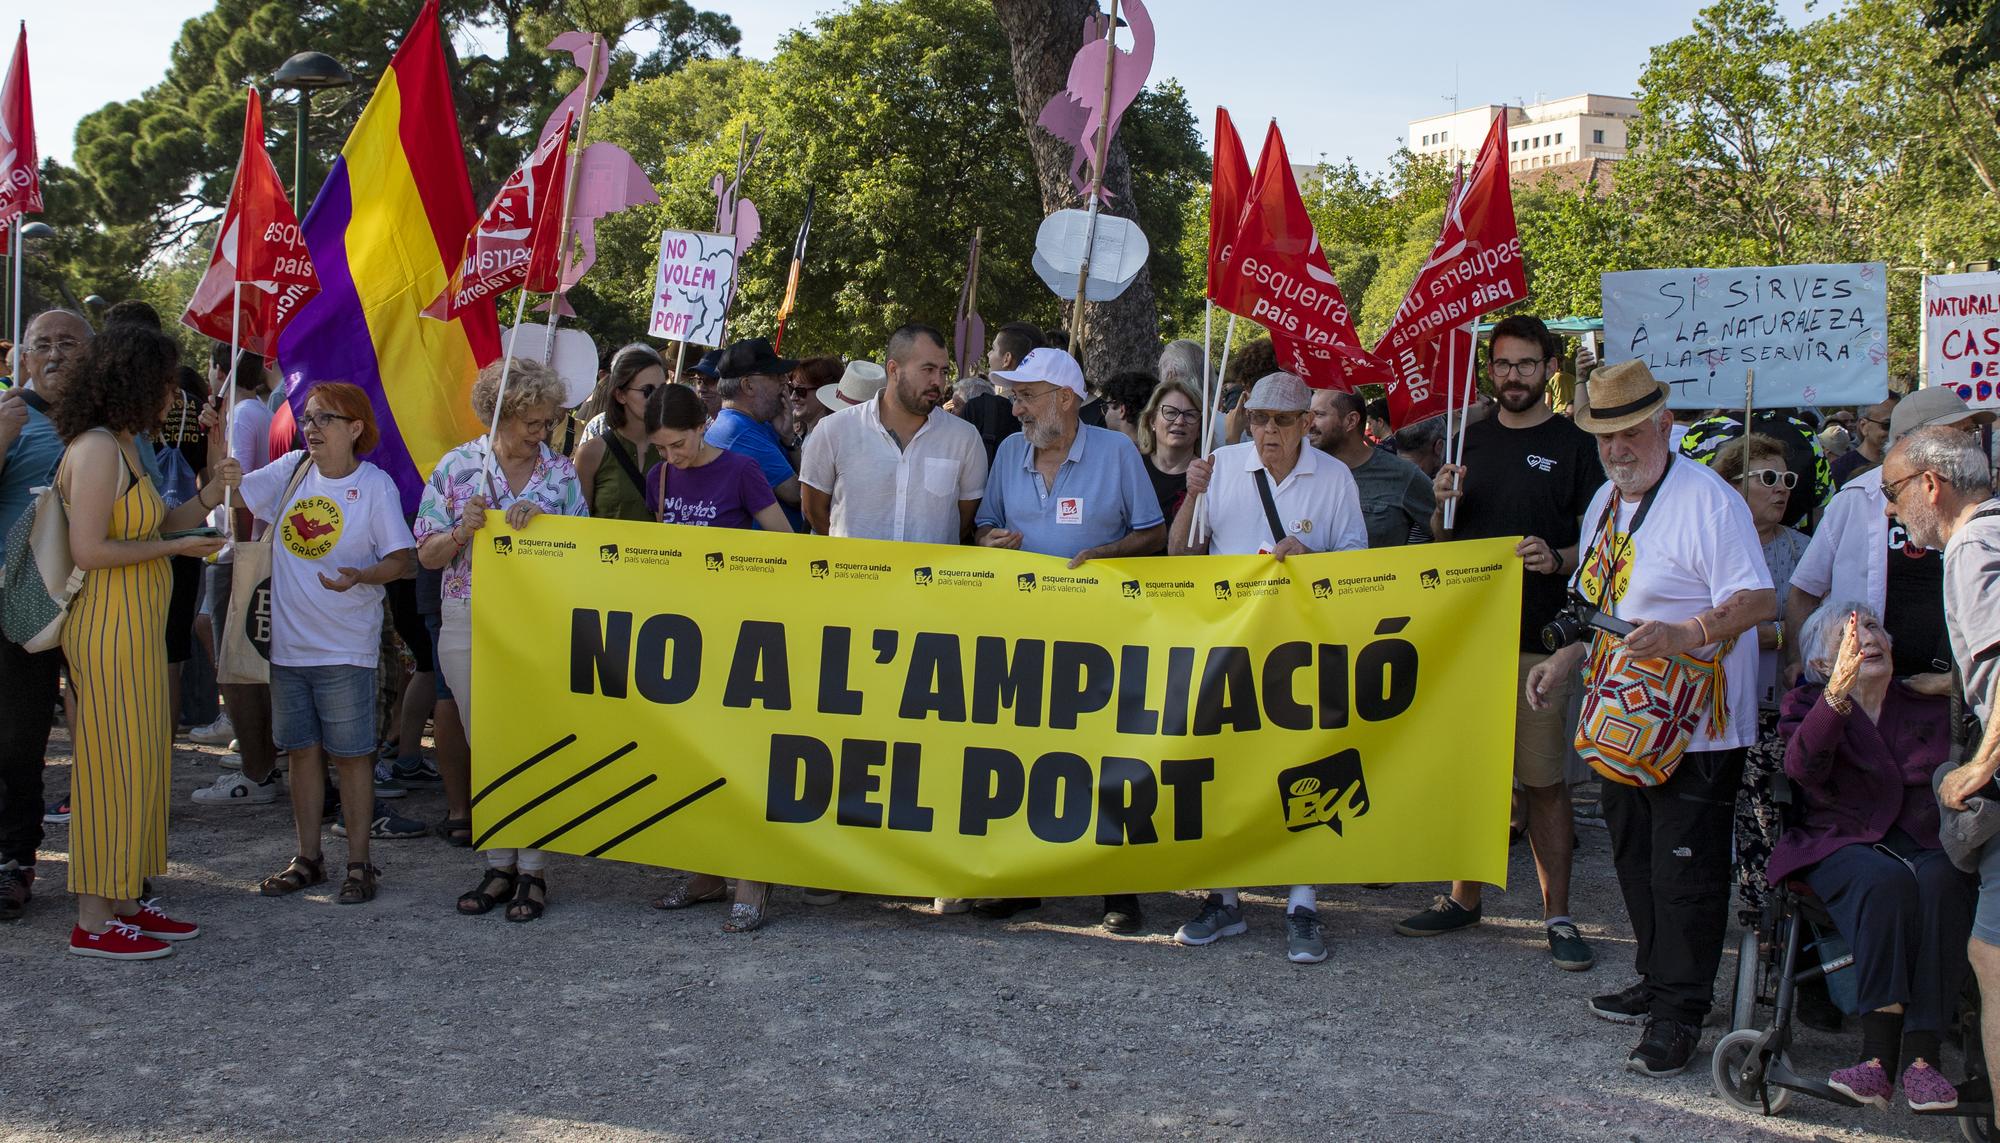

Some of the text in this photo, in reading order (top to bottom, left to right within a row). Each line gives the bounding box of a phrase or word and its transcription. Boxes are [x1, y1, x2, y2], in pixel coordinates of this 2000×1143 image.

[666, 239, 687, 260] NO
[273, 255, 312, 277] país
[664, 264, 716, 290] VOLEM
[1241, 257, 1348, 326] esquerra
[1929, 293, 2000, 317] NATURAL
[1252, 297, 1299, 331] país
[655, 311, 693, 335] PORT
[1676, 321, 1709, 342] LA
[282, 525, 293, 542] NO
[519, 537, 576, 549] esquerra unida
[625, 545, 682, 557] esquerra unida
[730, 554, 787, 565] esquerra unida
[835, 561, 892, 572] esquerra unida
[938, 568, 995, 579] esquerra unida
[1445, 563, 1503, 577] esquerra unida
[1042, 575, 1099, 586] esquerra unida
[1145, 580, 1195, 591] esquerra unida
[1236, 577, 1290, 590] esquerra unida
[1337, 572, 1396, 587] esquerra unida
[1585, 579, 1597, 596] NO
[571, 608, 1418, 736] NO A L'AMPLIACIÓ
[766, 734, 1214, 846] DEL PORT
